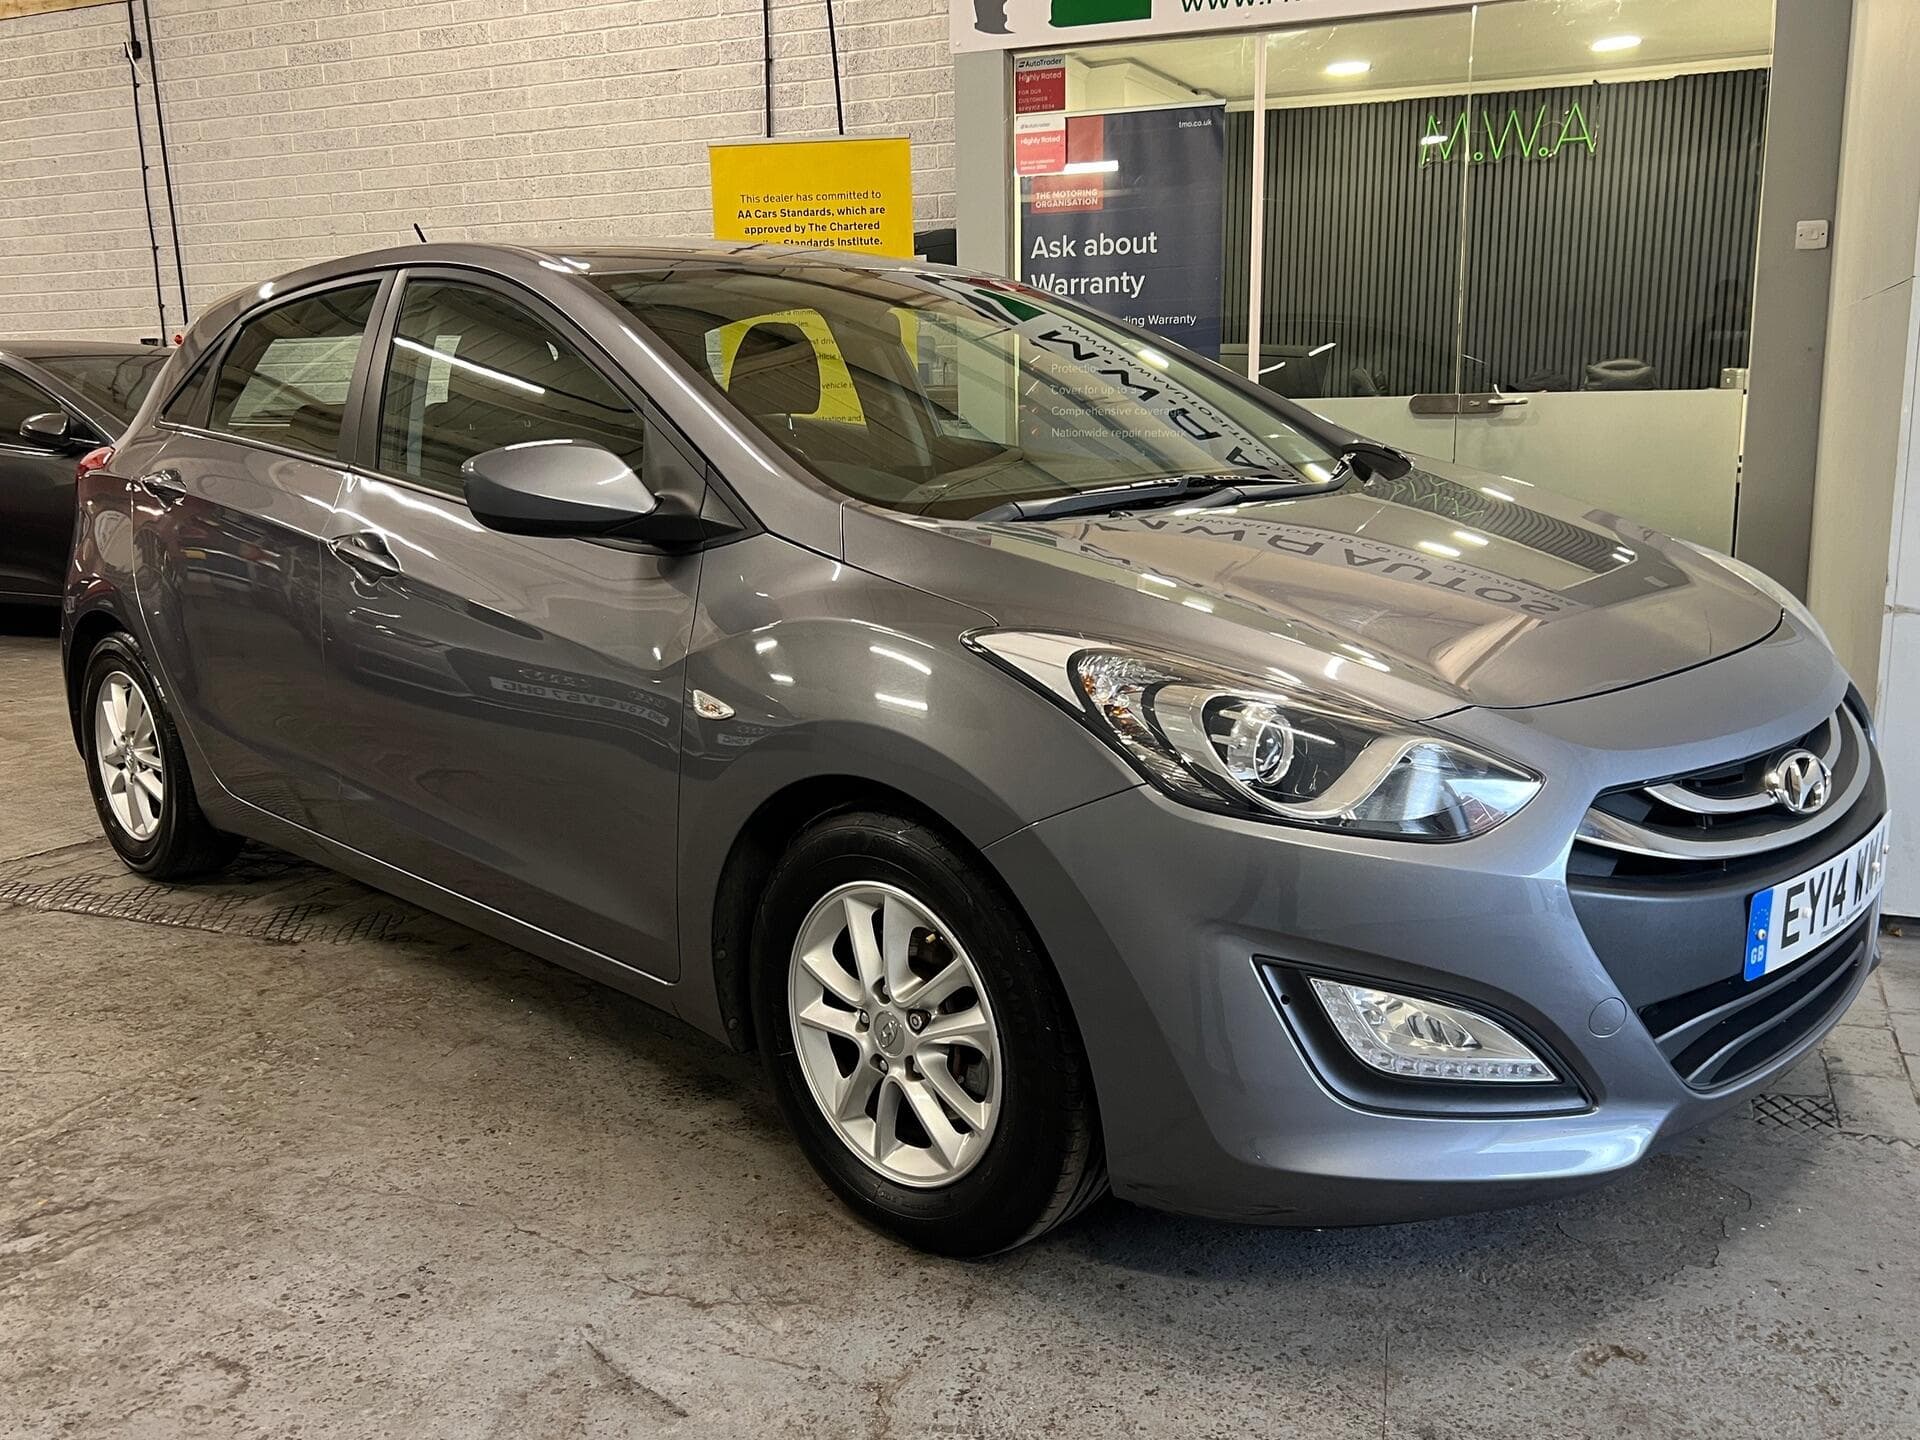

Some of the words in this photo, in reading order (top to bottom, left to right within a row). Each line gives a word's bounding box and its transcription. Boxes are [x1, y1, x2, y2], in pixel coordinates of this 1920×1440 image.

[1025, 58, 1062, 67] AutoTrader
[1018, 72, 1040, 83] Highly
[1041, 71, 1062, 80] Rated
[1178, 119, 1212, 128] tmo.co.uk
[1020, 137, 1040, 146] Highly
[1041, 135, 1061, 144] Rated
[1421, 102, 1596, 166] M.W.A
[740, 194, 760, 204] This
[763, 193, 793, 203] dealer
[796, 191, 814, 202] has
[816, 190, 869, 201] committed
[871, 190, 881, 199] to
[1035, 191, 1051, 201] THE
[1052, 188, 1098, 200] MOTORING
[1035, 198, 1099, 209] ORGANISATION
[738, 210, 752, 219] AA
[754, 209, 777, 219] Cars
[780, 207, 835, 218] Standards,
[837, 205, 867, 216] which
[869, 206, 886, 215] are
[744, 223, 792, 235] approved
[794, 222, 806, 234] by
[808, 222, 827, 232] The
[829, 220, 880, 231] Chartered
[837, 236, 883, 247] Institute.
[1030, 234, 1077, 260] Ask
[1084, 231, 1158, 257] about
[1031, 271, 1146, 299] Warranty
[1148, 313, 1197, 327] Warranty
[1051, 406, 1131, 418] Comprehensive
[1051, 428, 1108, 438] Nationwide
[1111, 427, 1142, 439] repair
[1781, 858, 1848, 949] EY14
[1750, 944, 1764, 965] GB
